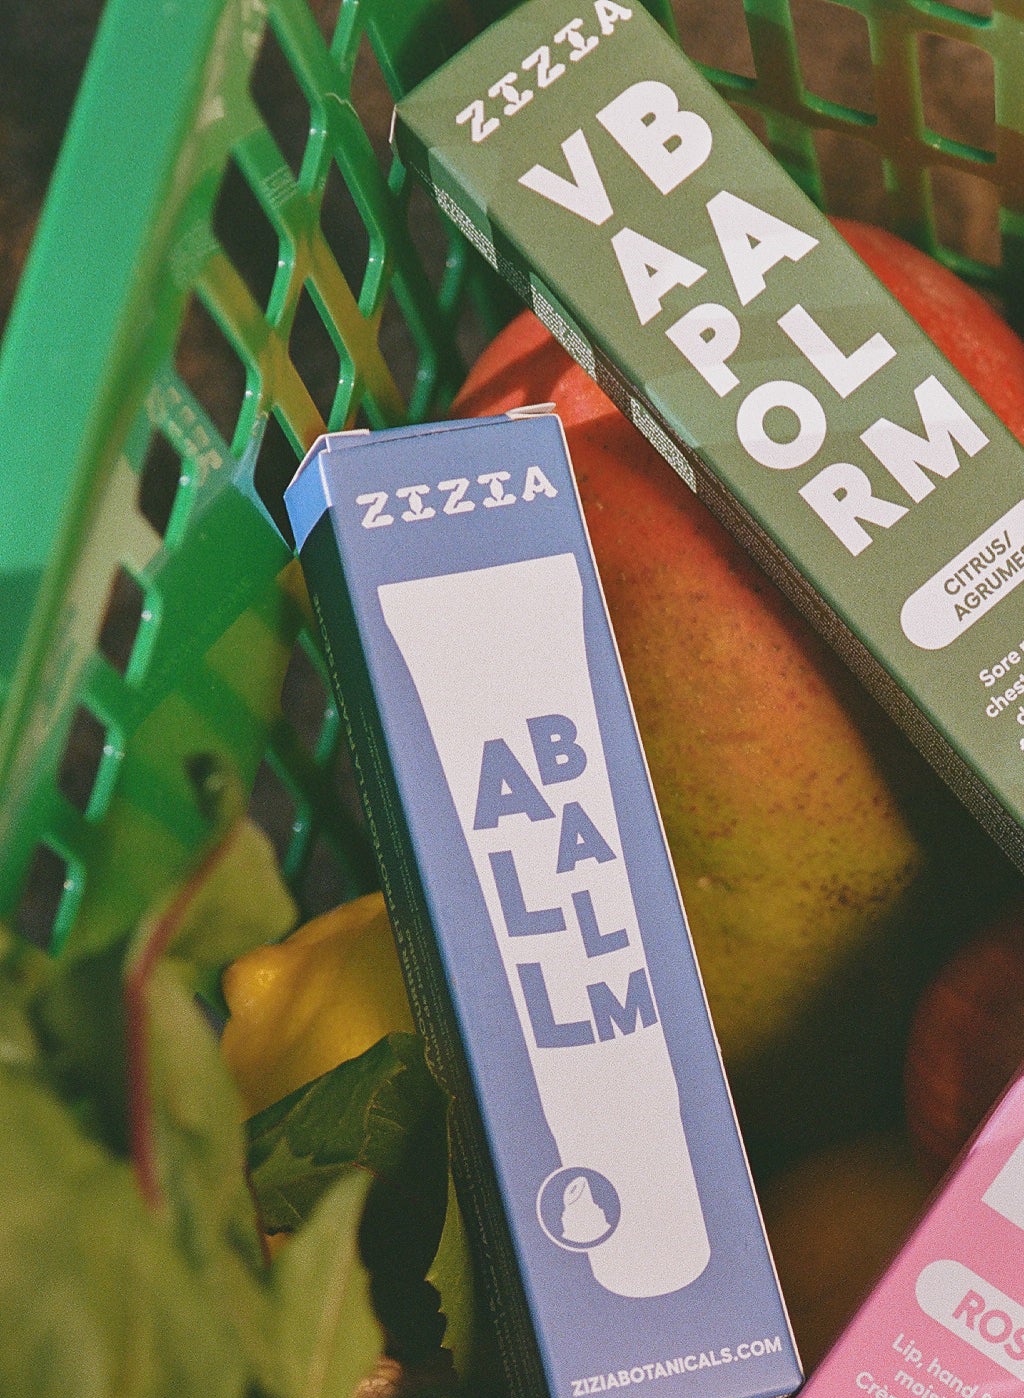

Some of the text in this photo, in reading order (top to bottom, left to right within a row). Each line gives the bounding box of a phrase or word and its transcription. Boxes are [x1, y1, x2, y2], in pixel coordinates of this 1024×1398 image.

[456, 0, 633, 143] ZIZIA
[354, 464, 559, 530] ZIZIA
[944, 530, 1011, 595] CITRUS/
[979, 651, 1020, 687] Sore
[571, 1336, 782, 1396] ZIZIABOTANICALS.COM
[892, 1333, 923, 1368] Lip,
